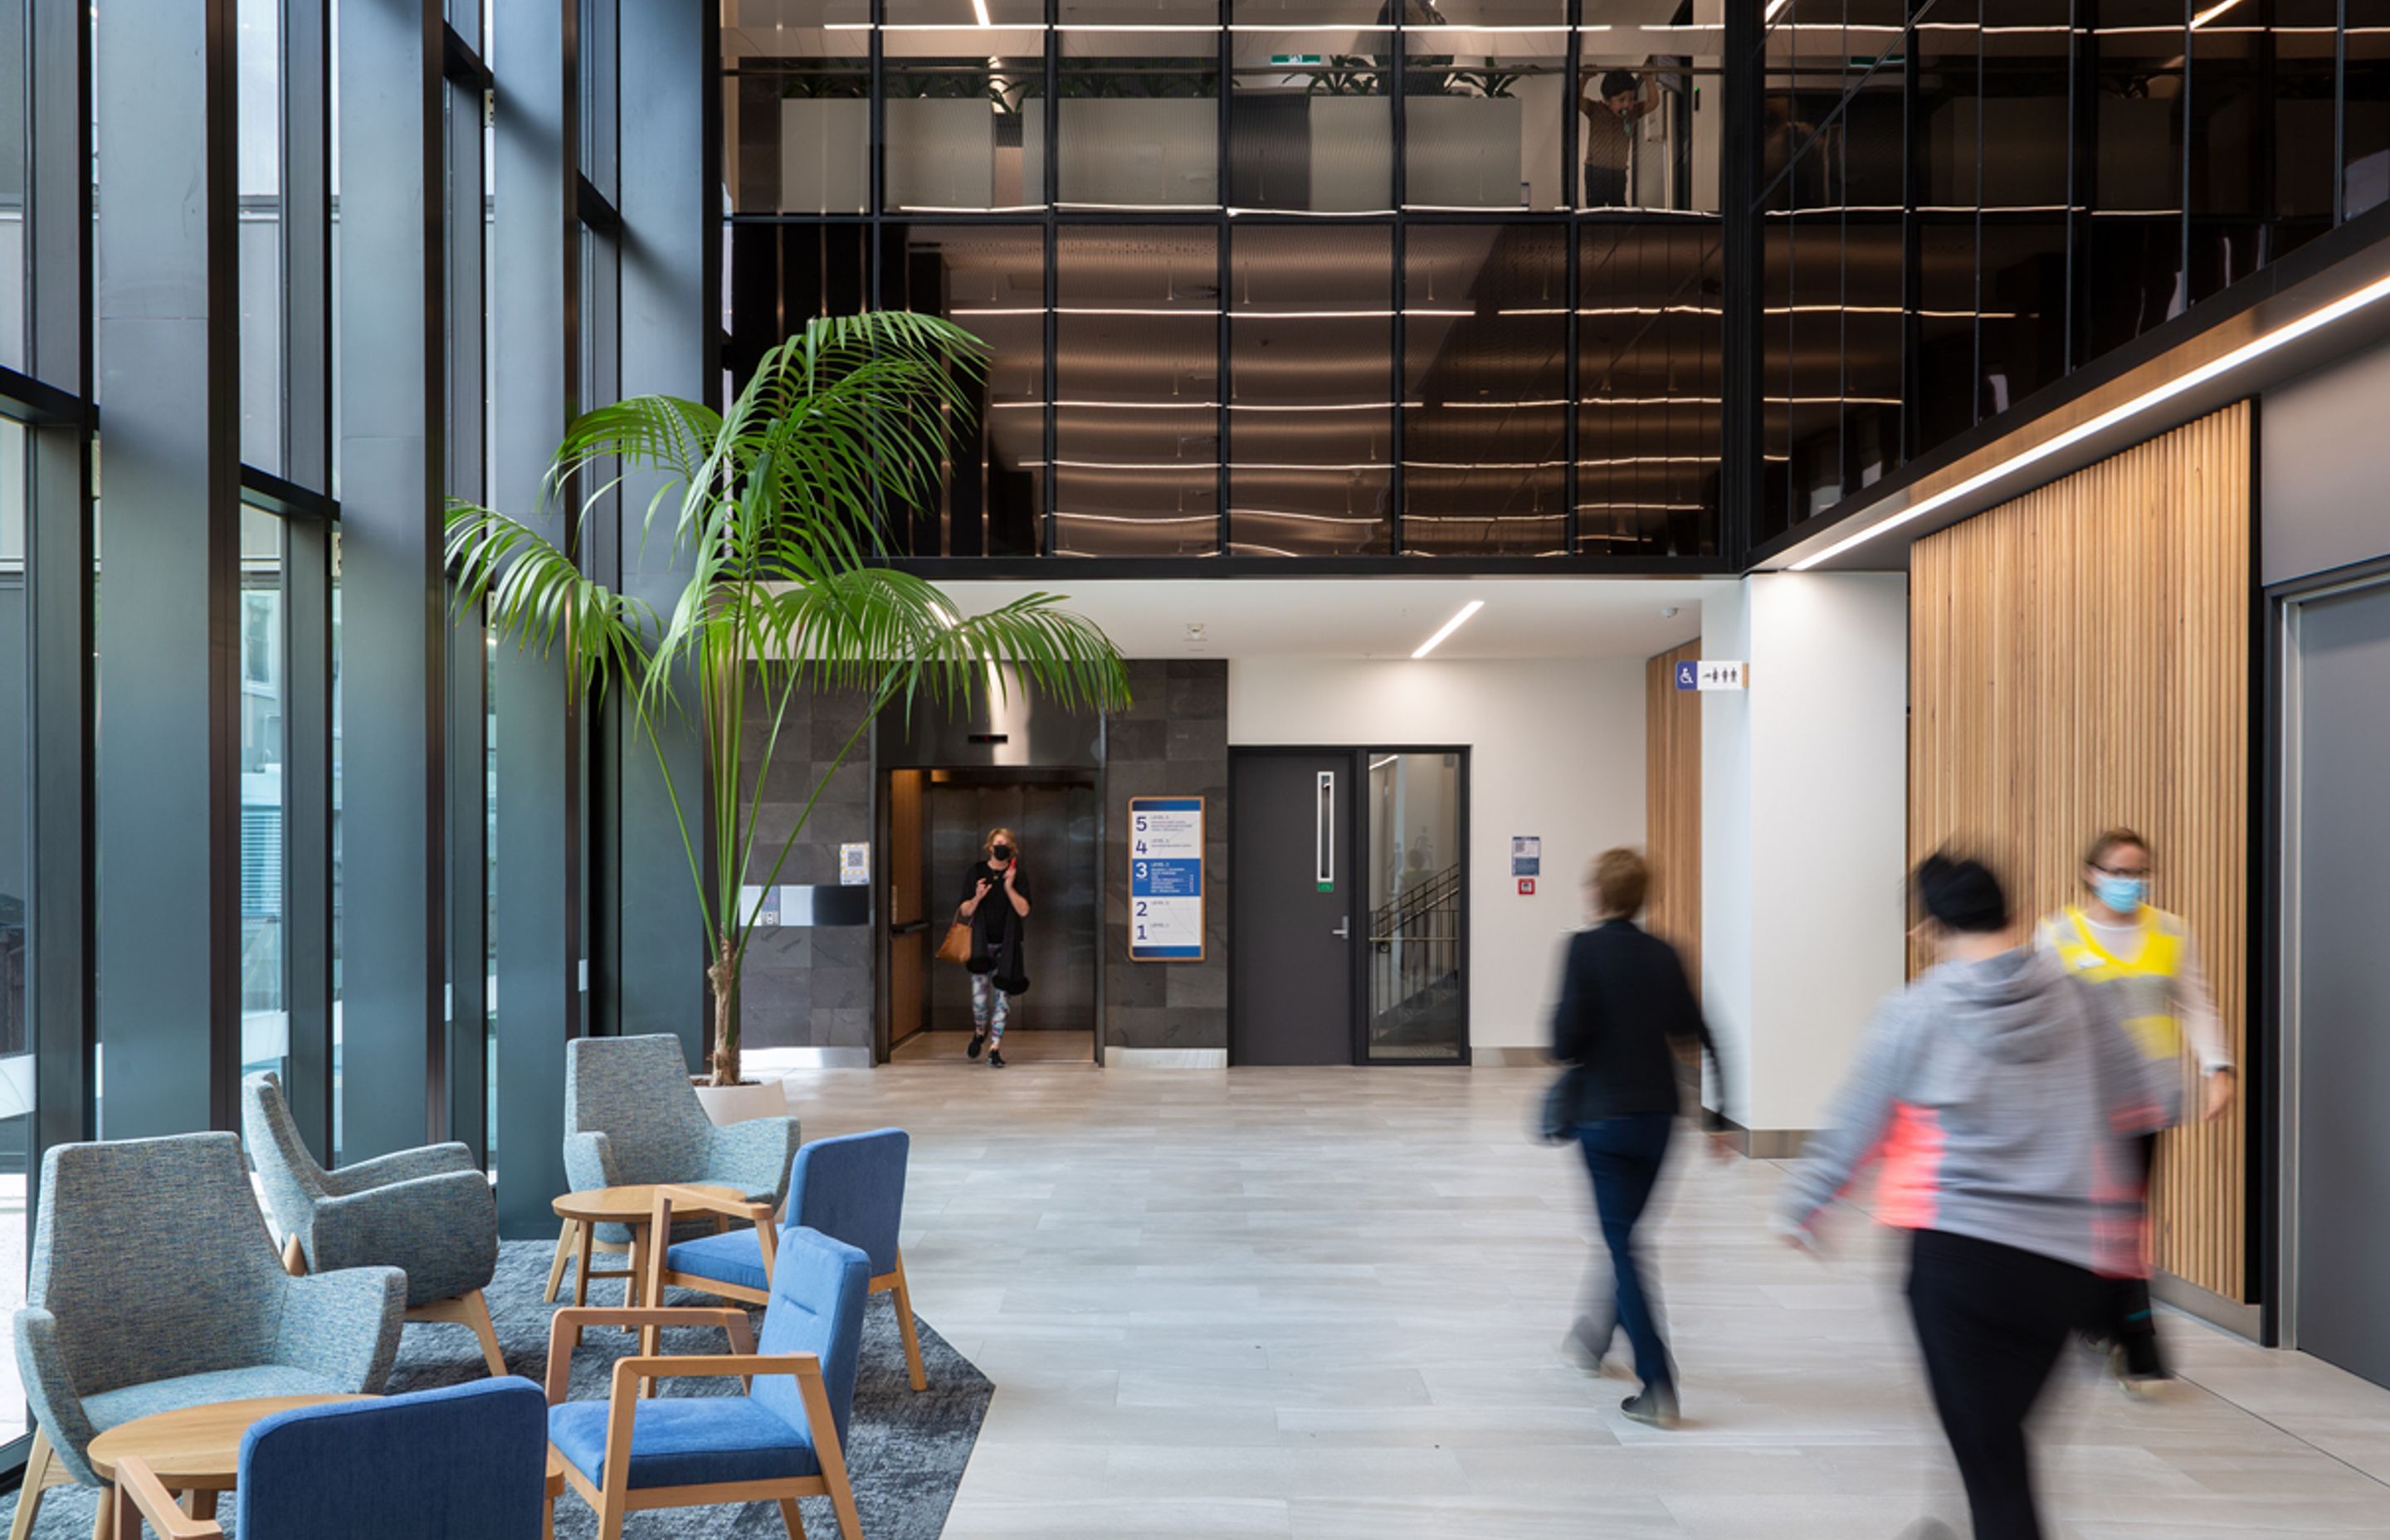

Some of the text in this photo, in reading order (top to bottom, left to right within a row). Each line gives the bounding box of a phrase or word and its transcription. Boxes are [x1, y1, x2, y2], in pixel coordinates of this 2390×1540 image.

[1136, 816, 1147, 831] 5
[1136, 839, 1148, 855] 4
[1136, 862, 1148, 878] 3
[1136, 901, 1148, 916] 2
[1137, 924, 1147, 940] 1
